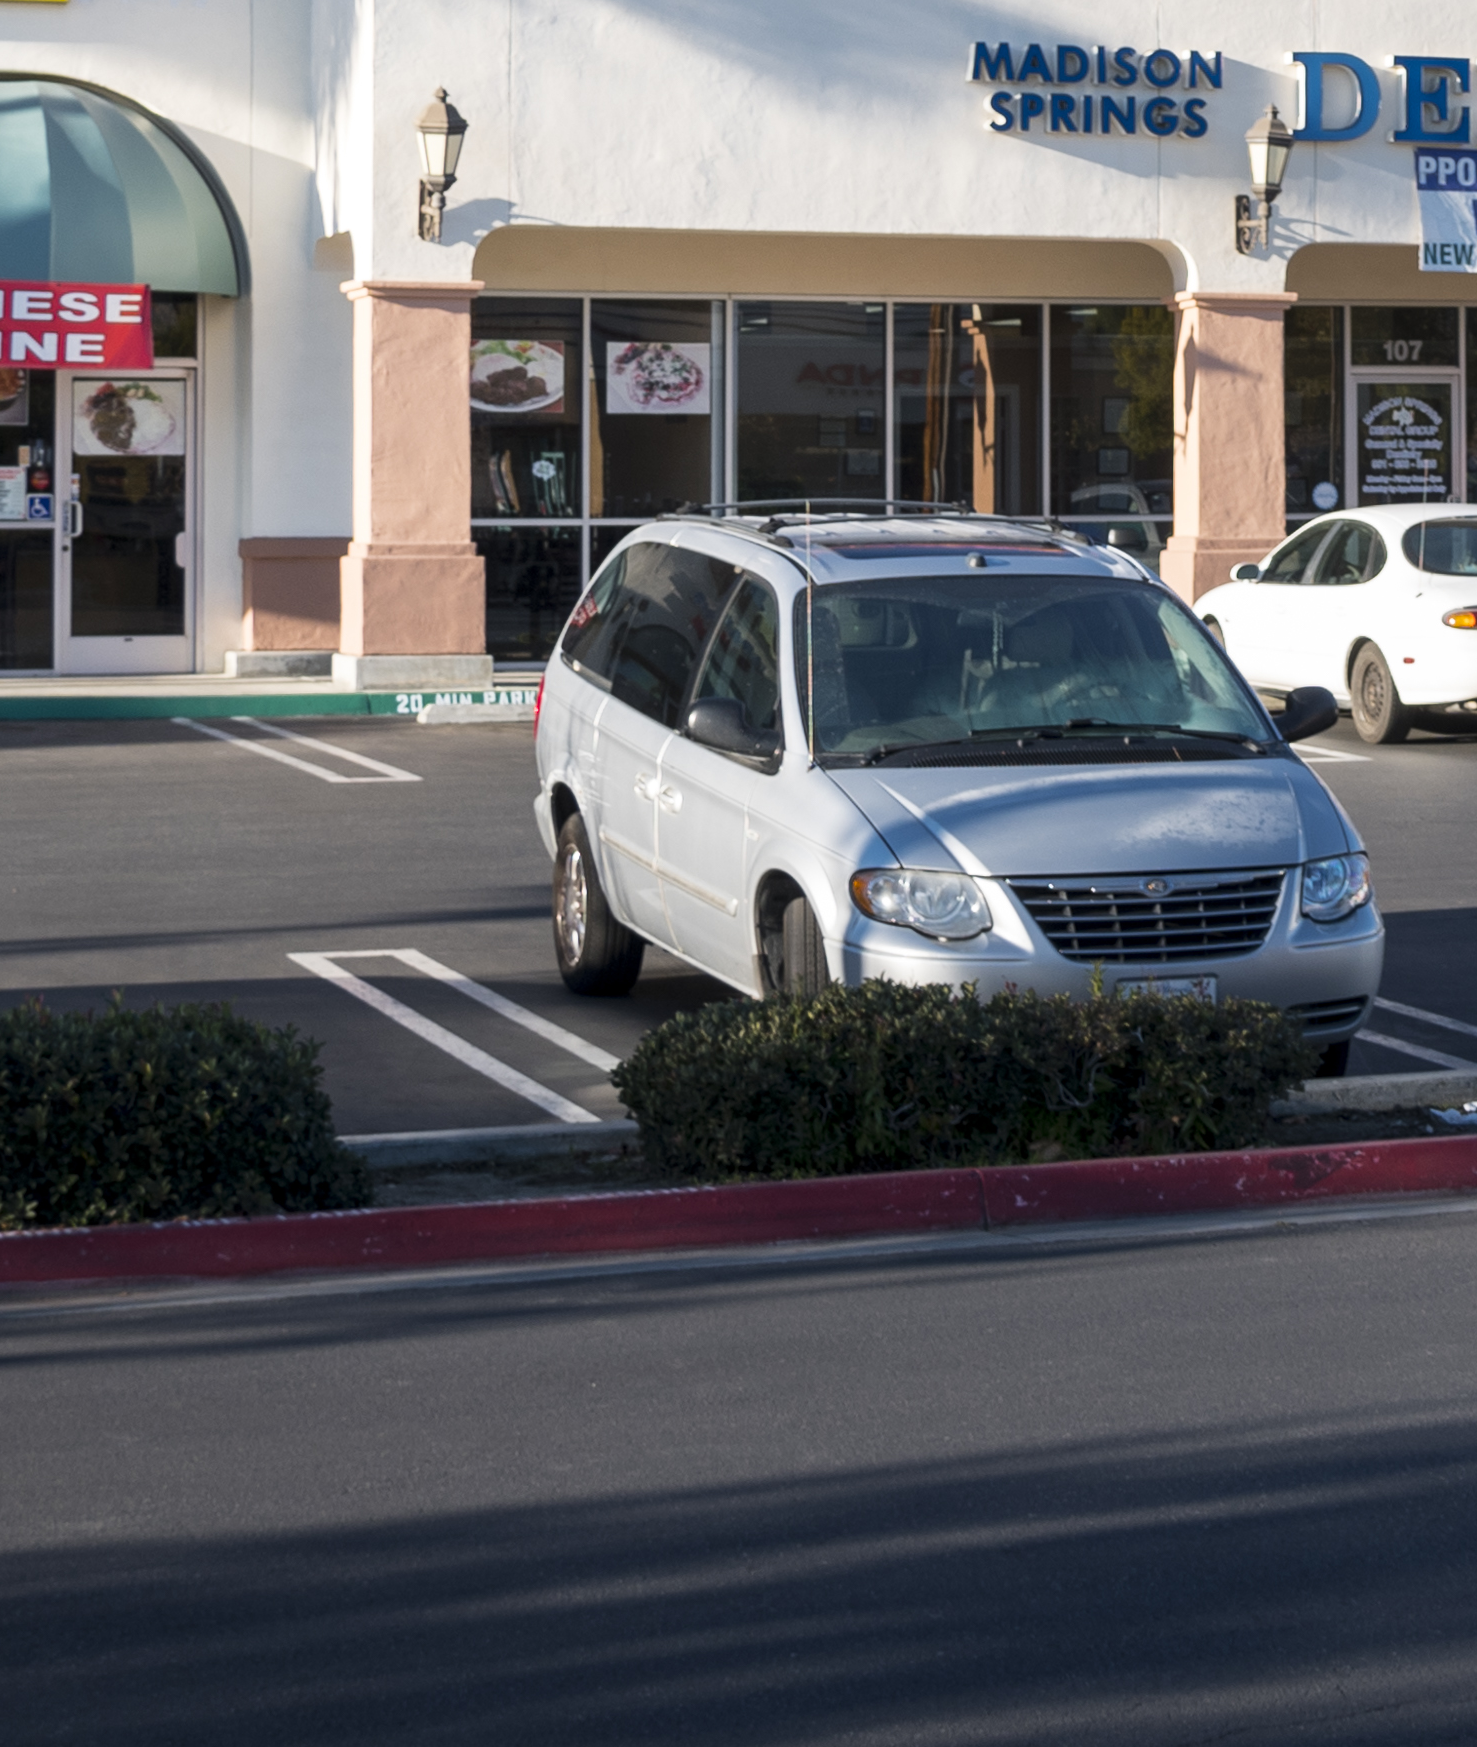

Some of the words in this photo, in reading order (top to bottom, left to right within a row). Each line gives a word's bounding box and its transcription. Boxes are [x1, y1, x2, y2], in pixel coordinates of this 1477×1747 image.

[967, 41, 1223, 90] MADISON
[982, 90, 1209, 140] SPRINGS
[1423, 242, 1475, 268] NEW
[1383, 339, 1423, 362] 107
[396, 693, 423, 714] 20
